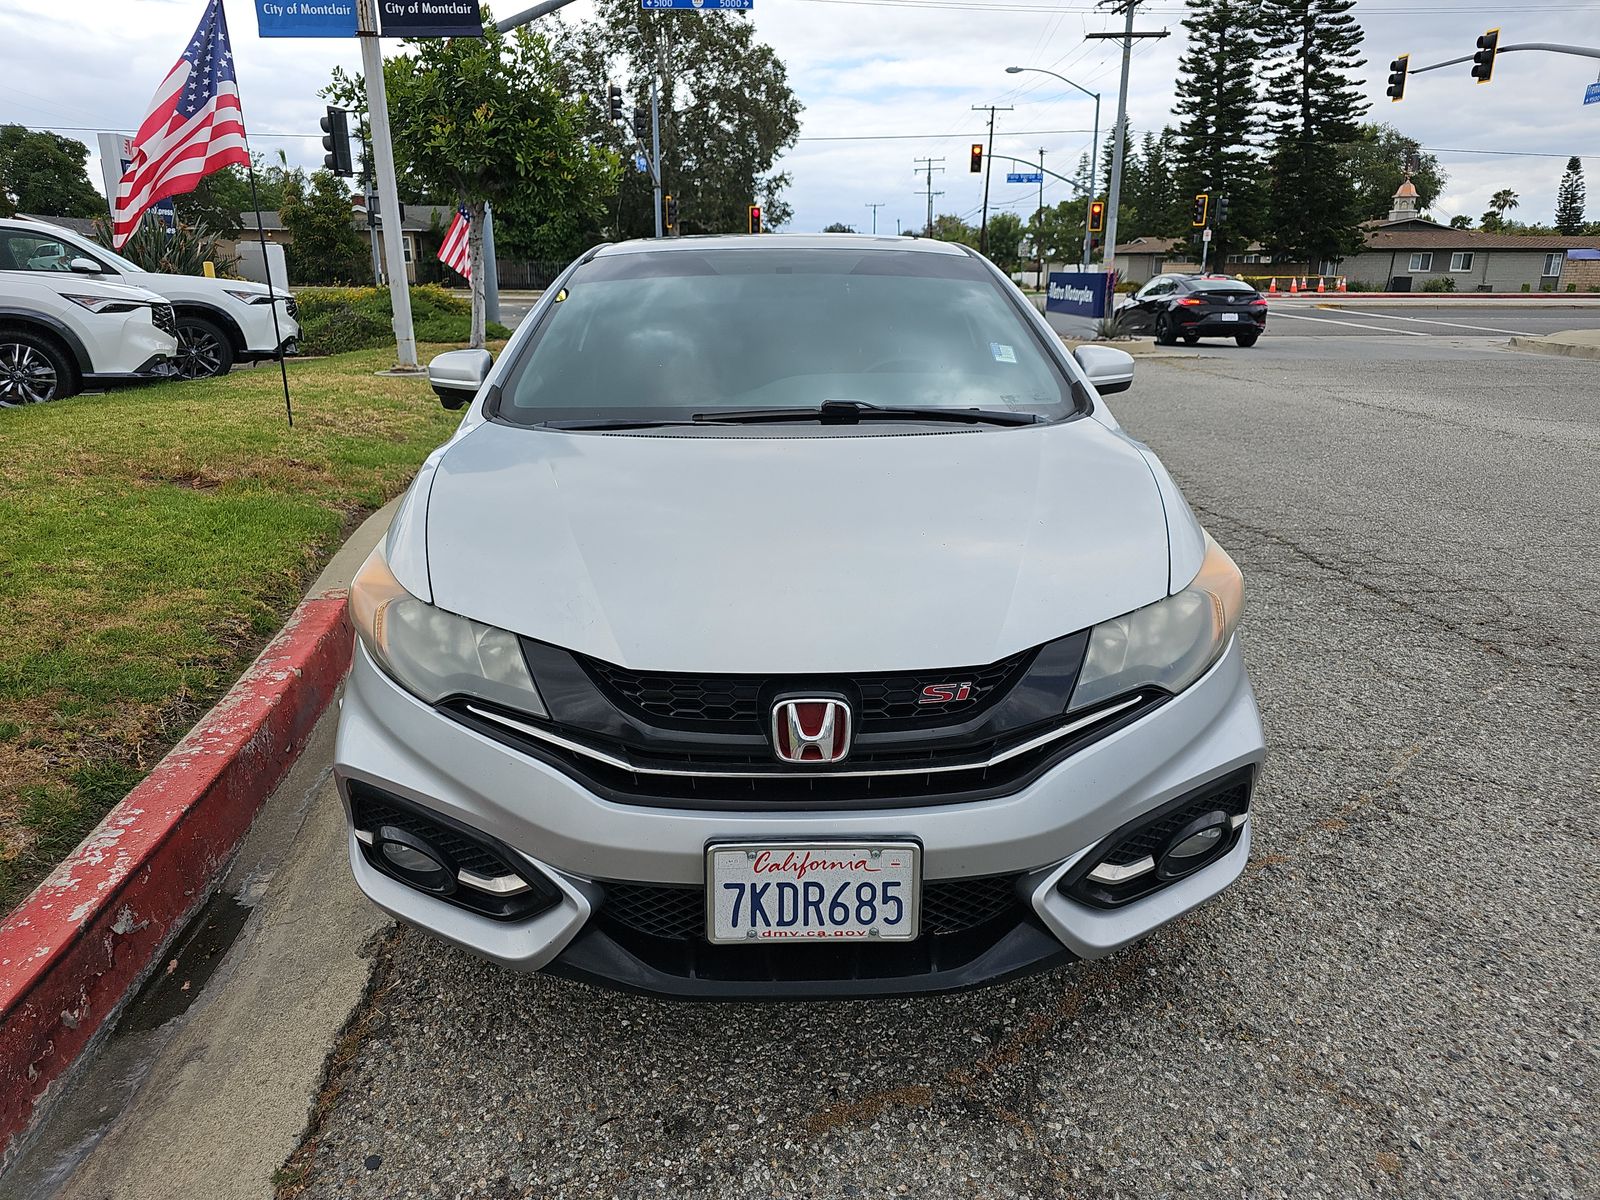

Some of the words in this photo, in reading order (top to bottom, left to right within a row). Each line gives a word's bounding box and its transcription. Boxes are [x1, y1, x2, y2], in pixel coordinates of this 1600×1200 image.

[263, 4, 285, 16] City
[287, 3, 298, 15] of
[301, 3, 352, 15] Montclair
[385, 2, 405, 16] City
[408, 2, 419, 14] of
[422, 2, 472, 15] Montclair
[1065, 284, 1094, 305] Motorplex
[919, 682, 972, 704] Si
[753, 851, 881, 879] California
[723, 881, 904, 928] 7KDR685
[762, 930, 867, 938] dmv.ca.gov
